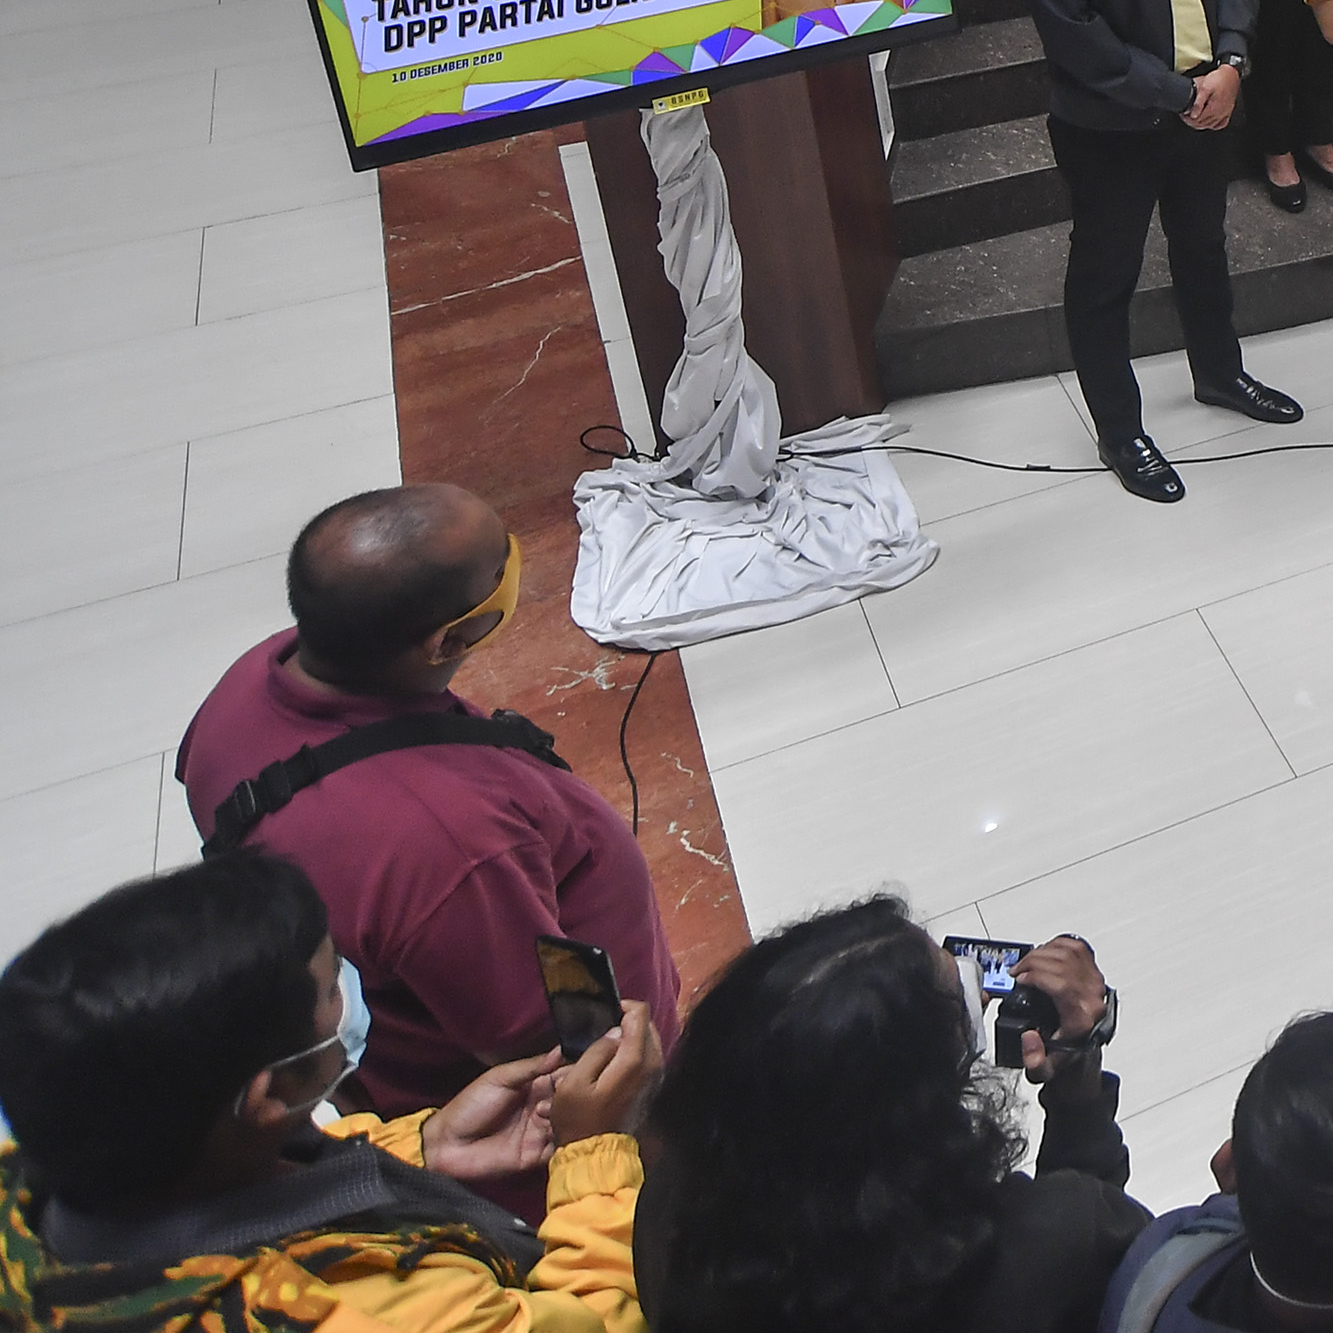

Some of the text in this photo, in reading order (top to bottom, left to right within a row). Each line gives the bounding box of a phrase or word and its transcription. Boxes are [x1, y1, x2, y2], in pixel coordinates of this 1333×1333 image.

[382, 14, 447, 53] DPP
[391, 51, 503, 84] 10 DESEMBER 2020
